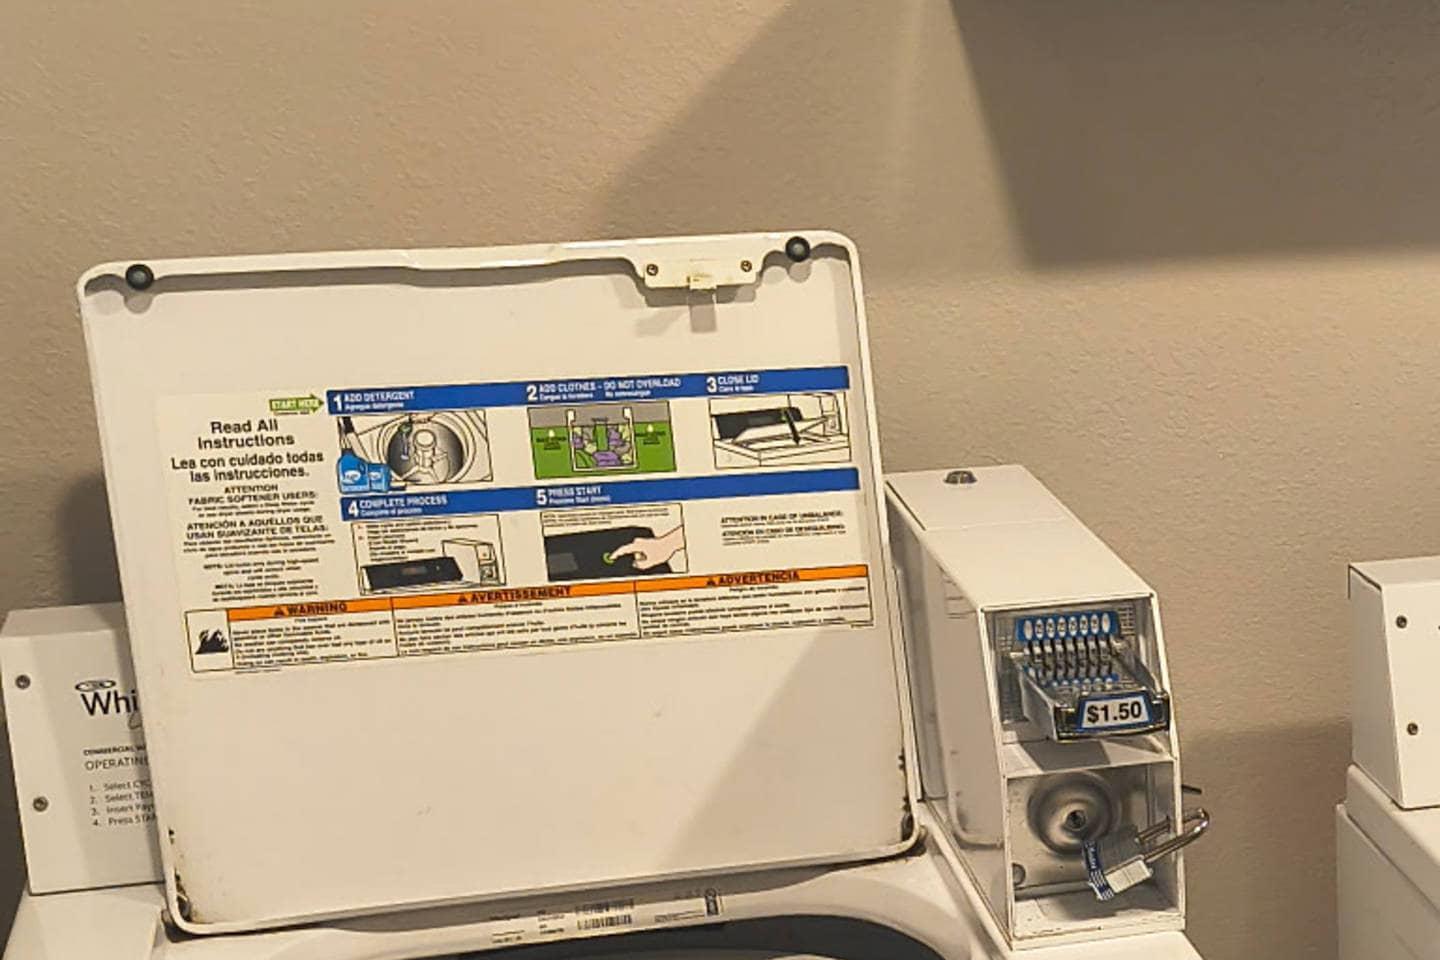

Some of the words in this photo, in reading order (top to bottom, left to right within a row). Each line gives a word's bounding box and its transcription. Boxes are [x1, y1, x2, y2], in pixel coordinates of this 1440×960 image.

[527, 385, 538, 400] 2
[539, 384, 556, 393] ADD
[558, 382, 596, 392] CLOTHES
[604, 381, 617, 390] DO
[618, 380, 634, 389] NOT
[636, 378, 681, 389] OVERLOAD
[706, 376, 717, 393] 3
[718, 375, 744, 385] CLOSE
[746, 374, 760, 384] LID
[333, 394, 342, 411] 1
[344, 393, 362, 403] ADD
[363, 391, 415, 402] DETERGENT
[210, 420, 252, 434] Read
[257, 418, 279, 432] All
[198, 434, 295, 450] Instructions
[171, 456, 196, 470] Lea
[200, 457, 226, 469] con
[229, 453, 283, 467] cuidado
[286, 450, 324, 464] todas
[190, 470, 211, 483] las
[214, 466, 310, 482] instrucciones.
[224, 484, 279, 494] ATTENTION
[535, 489, 547, 505] 5
[548, 487, 574, 497] PRESS
[575, 486, 602, 496] START
[188, 496, 225, 506] FABRIC
[226, 493, 281, 505] SOFTENER
[348, 501, 359, 517] 4
[359, 497, 406, 509] COMPLETE
[407, 495, 448, 506] PROCESS
[239, 519, 247, 528] A
[302, 515, 324, 524] QUE
[186, 530, 215, 541] USAN
[216, 527, 277, 538] SUAVIZANTE
[279, 526, 293, 535] DE
[719, 571, 800, 586] ADVERTENCIA
[470, 586, 571, 603] AVERTISSEMENT
[287, 602, 348, 616] WARNING
[1087, 700, 1143, 724] $1.50
[104, 781, 131, 792] Select
[105, 792, 133, 803] Select
[108, 815, 134, 826] Press
